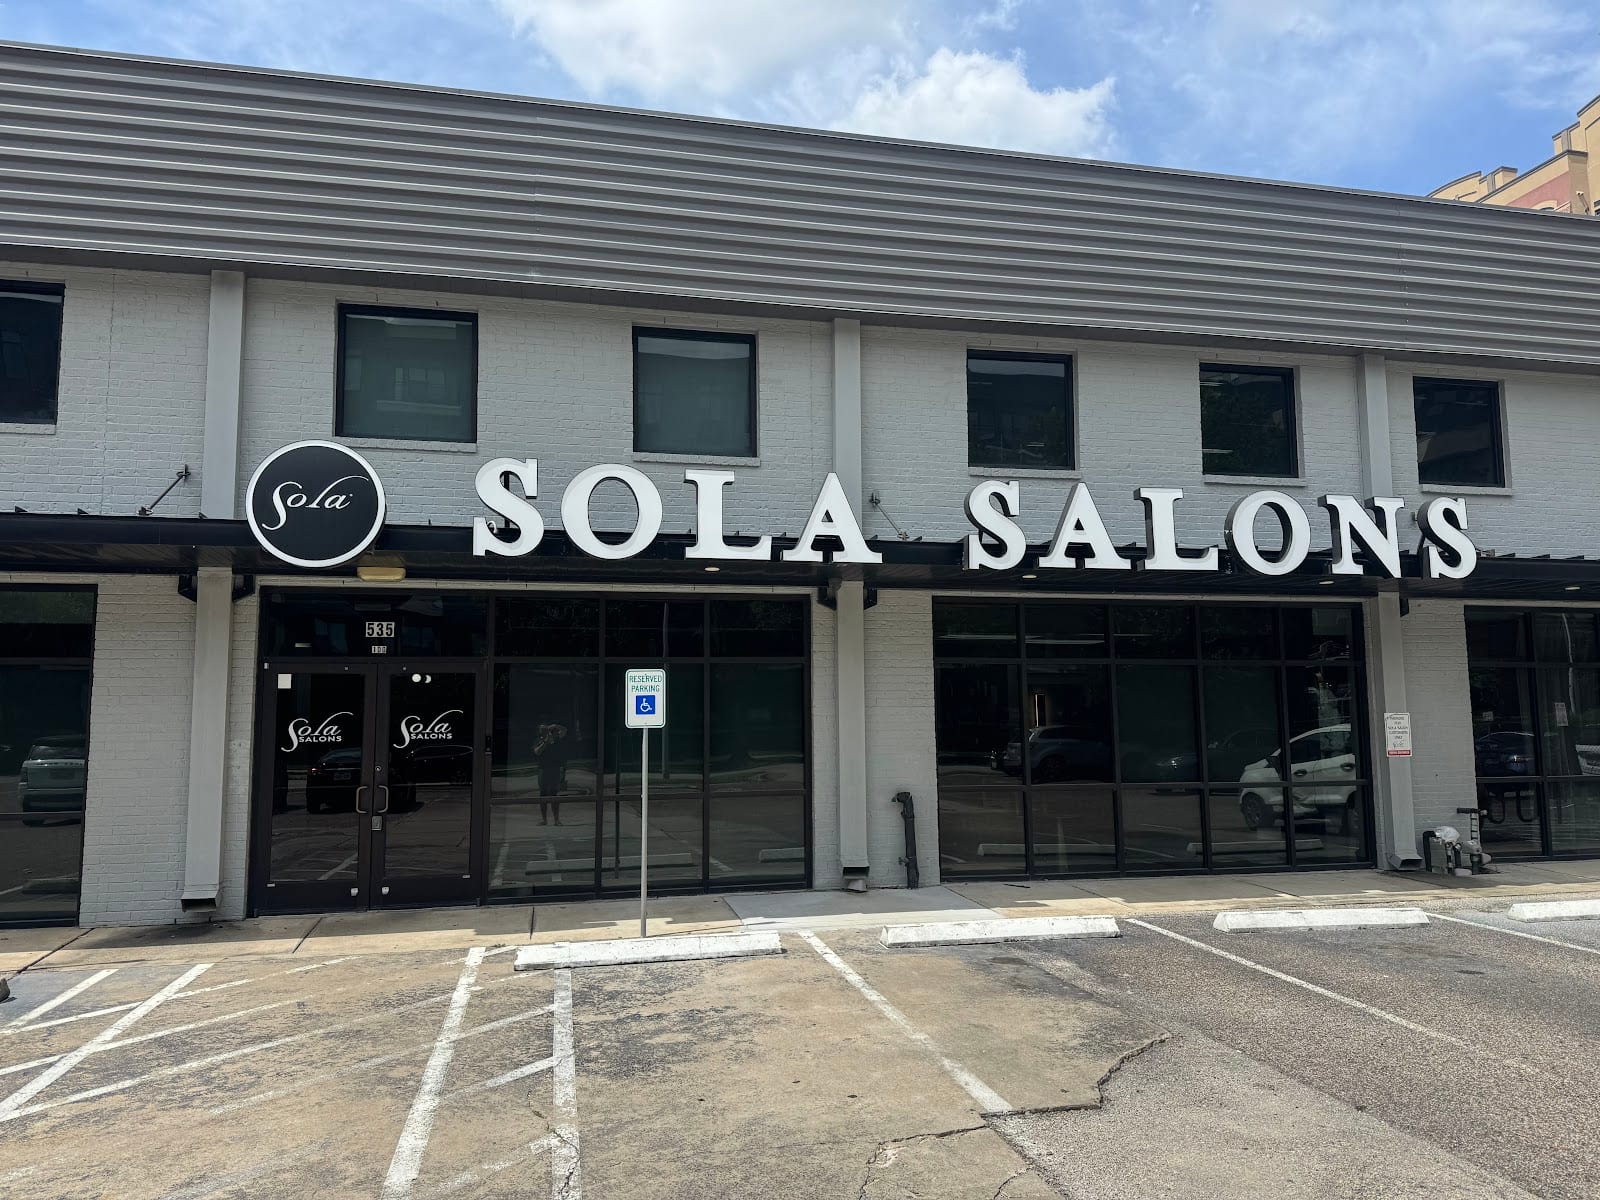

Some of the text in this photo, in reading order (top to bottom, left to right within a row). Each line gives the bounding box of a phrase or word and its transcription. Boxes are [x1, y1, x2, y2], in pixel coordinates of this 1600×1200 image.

[262, 475, 369, 531] Sola
[472, 457, 1478, 579] SOLA SALONS
[366, 622, 393, 637] 535
[629, 675, 663, 683] RESERVED
[281, 711, 354, 752] Sola
[298, 735, 343, 743] SALONS
[393, 709, 464, 749] Sola
[410, 732, 453, 740] SALONS
